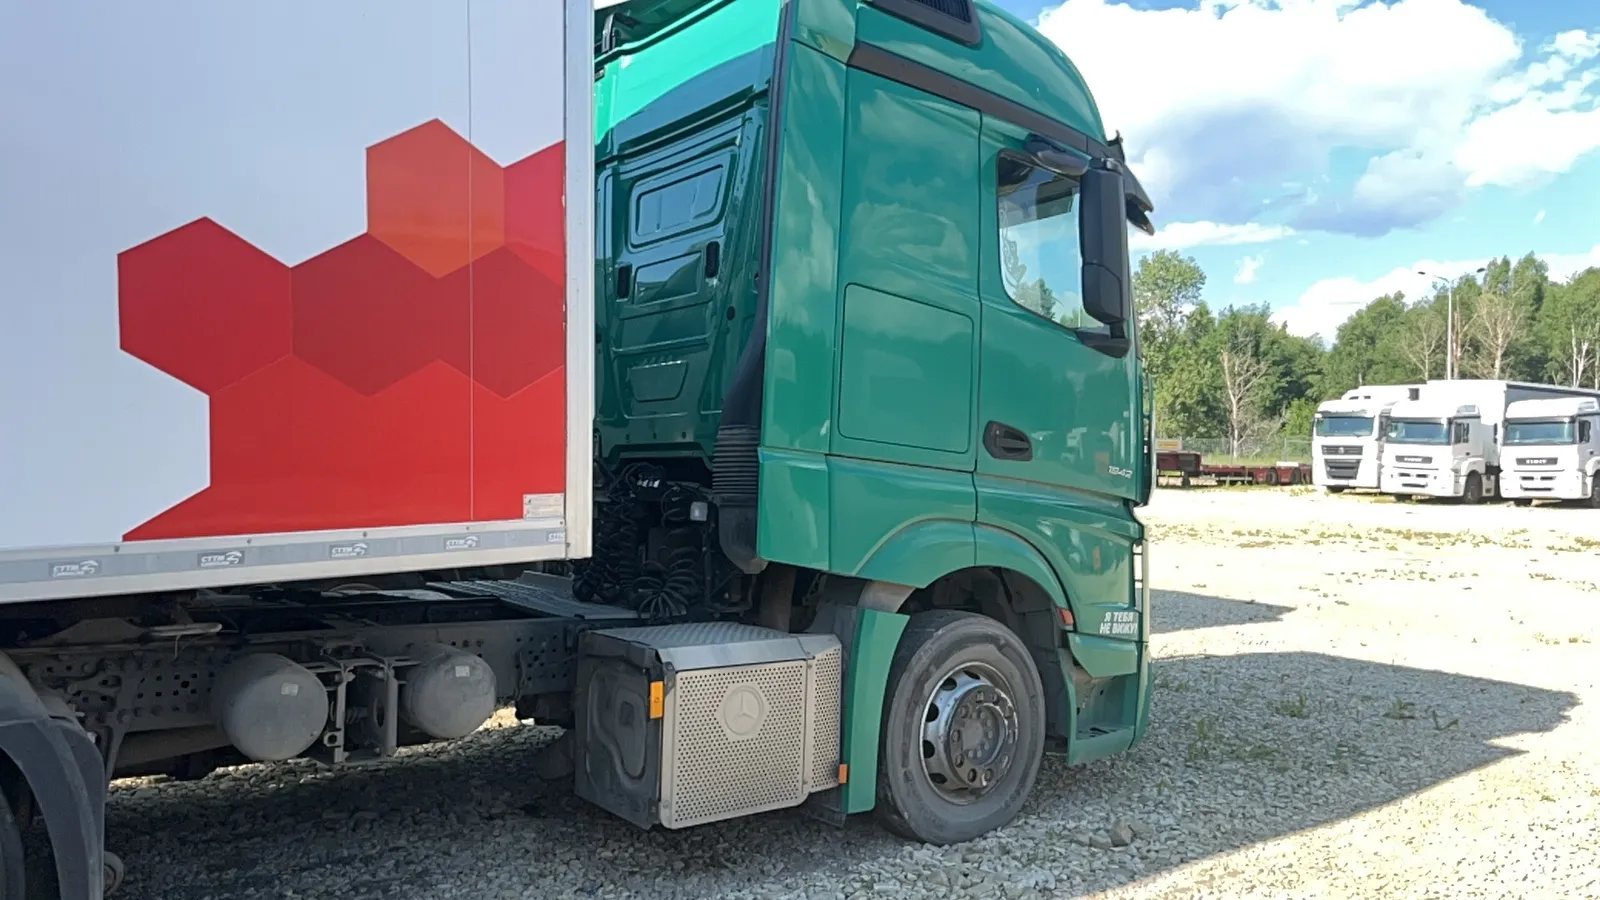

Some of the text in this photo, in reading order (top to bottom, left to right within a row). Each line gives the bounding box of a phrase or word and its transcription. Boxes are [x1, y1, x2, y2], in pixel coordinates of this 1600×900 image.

[1103, 611, 1134, 622] Я ТЕБЯ
[1099, 622, 1111, 634] НЕ
